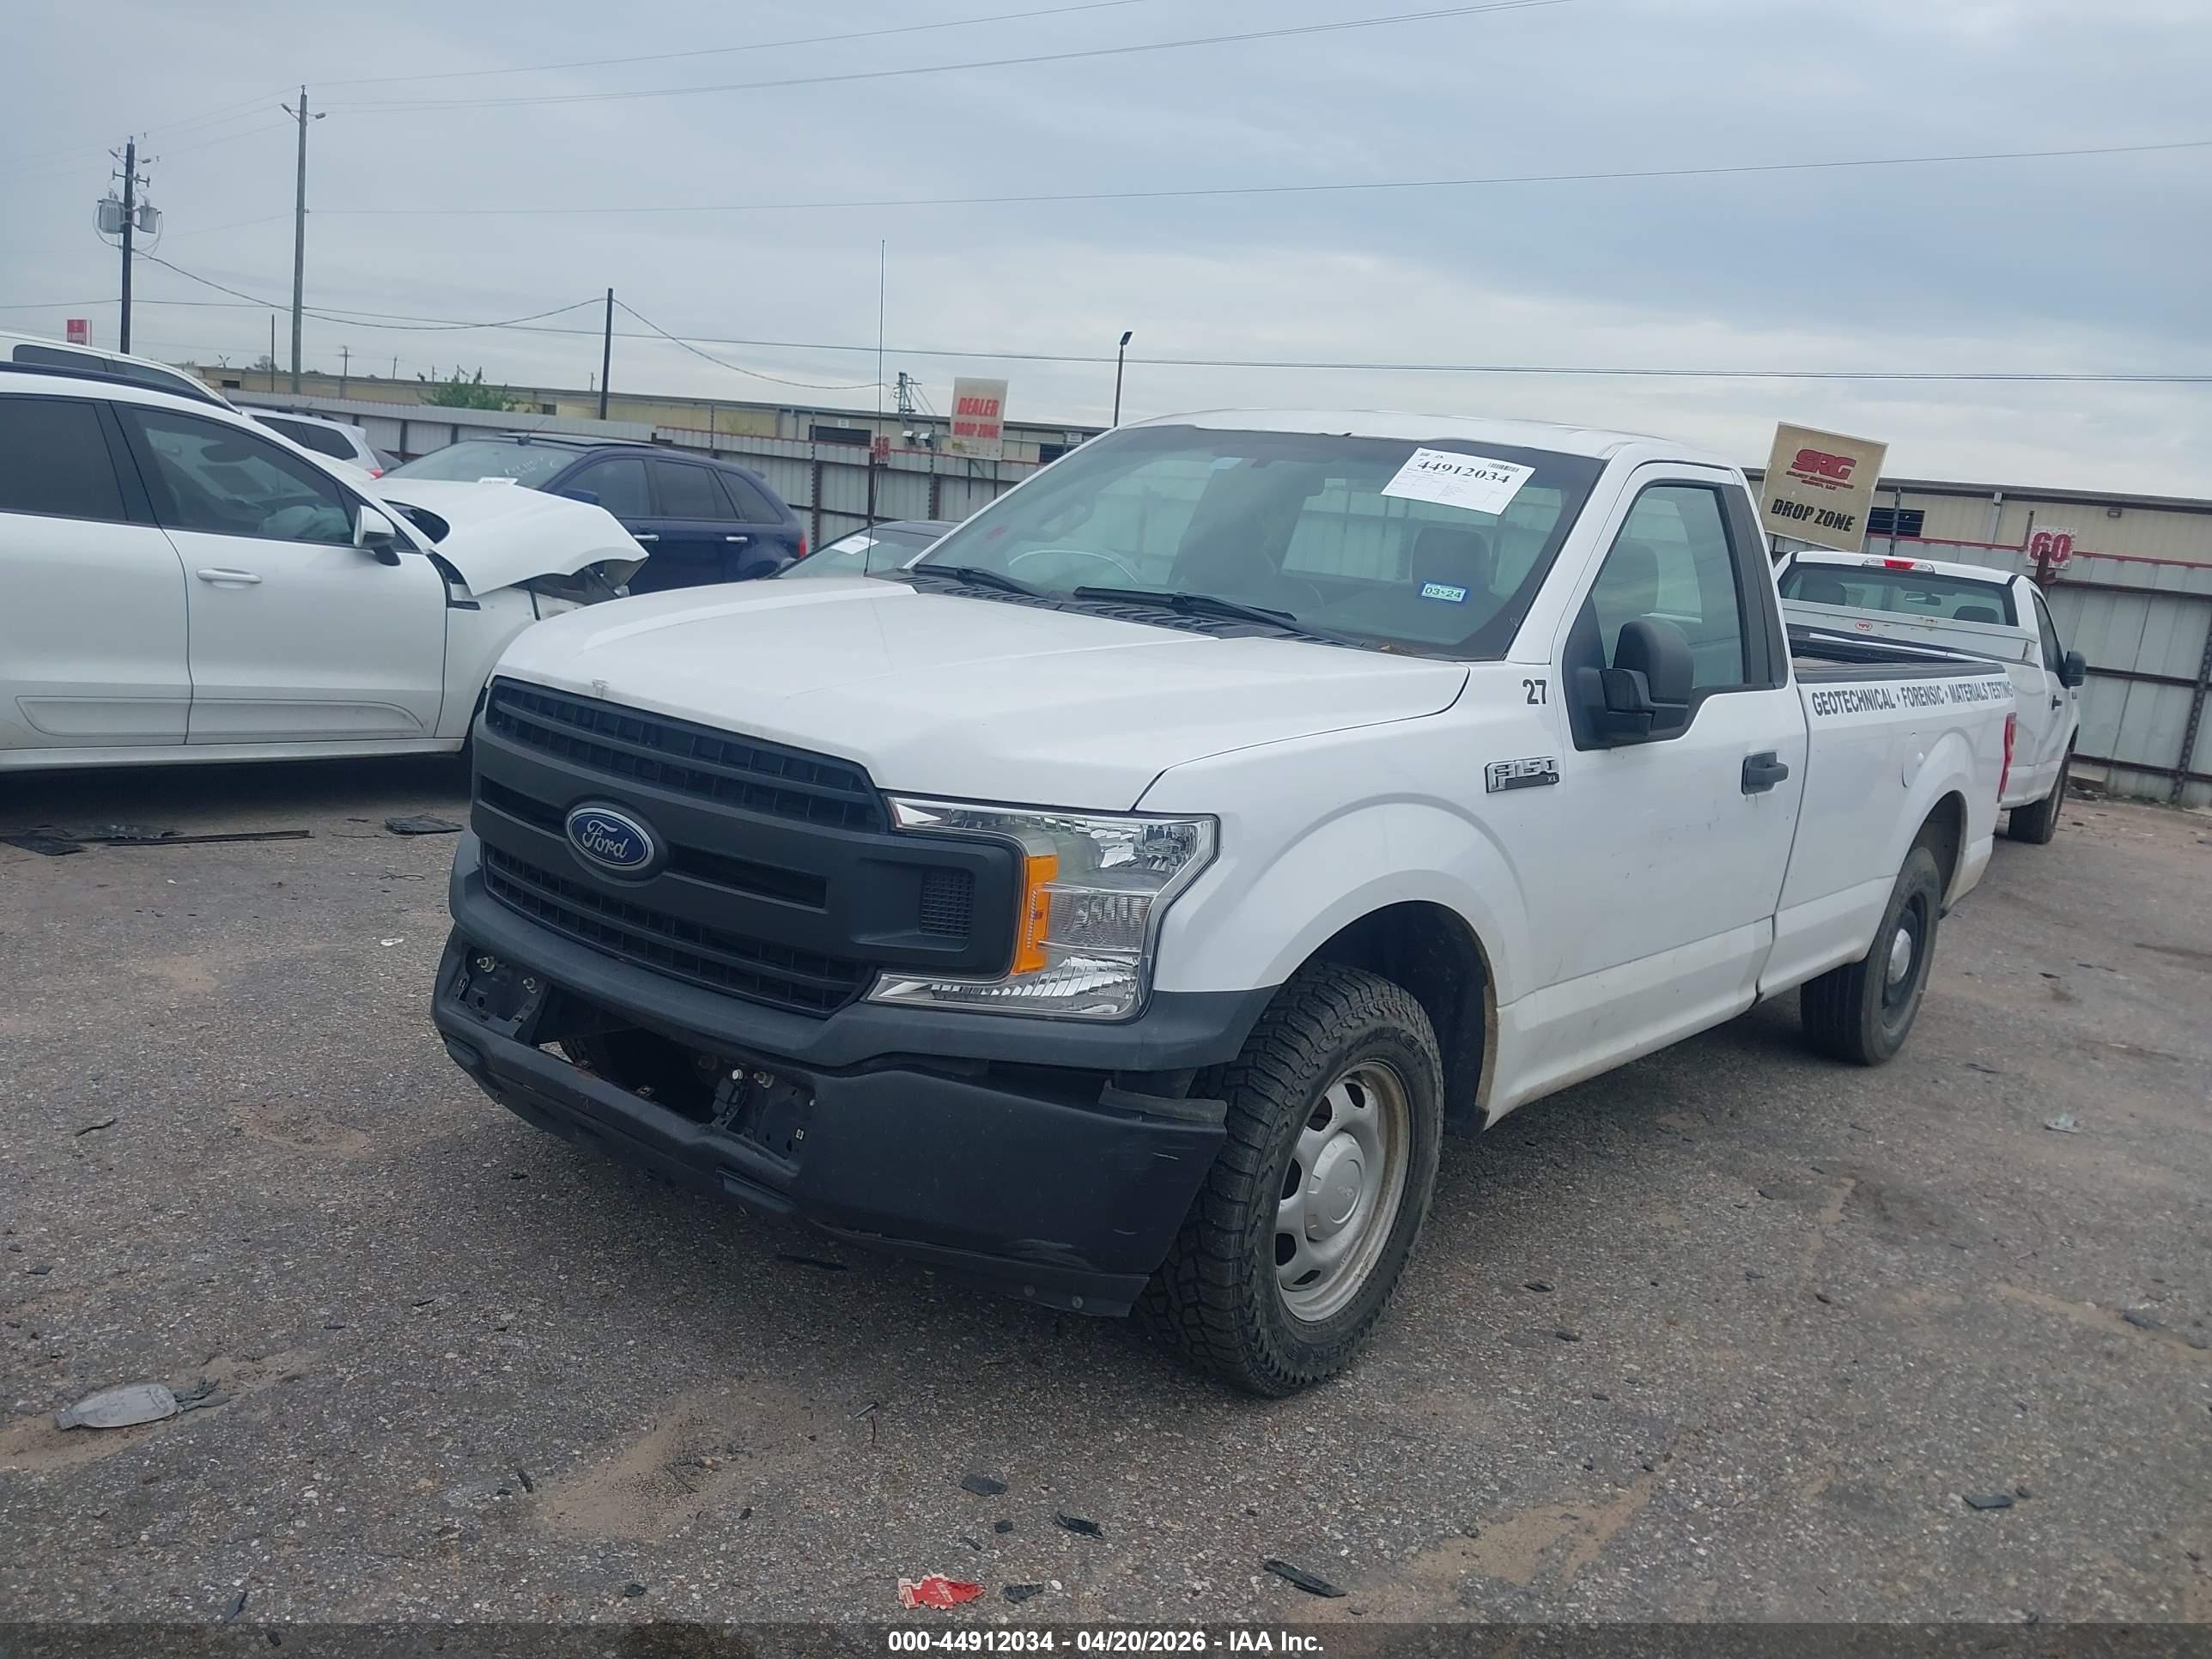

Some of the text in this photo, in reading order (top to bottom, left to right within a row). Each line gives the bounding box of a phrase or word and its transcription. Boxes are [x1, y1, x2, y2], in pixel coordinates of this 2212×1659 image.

[957, 398, 1000, 417] DEALER
[1417, 460, 1511, 483] 44912034
[1790, 448, 1856, 480] SRG
[1771, 498, 1856, 532] DROP ZONE
[2029, 532, 2072, 562] 60
[1522, 679, 1547, 704] 27
[1812, 678, 2014, 716] GEOTECHNICAL FORENSIC MATERIALS TESTING
[582, 819, 630, 859] Ford
